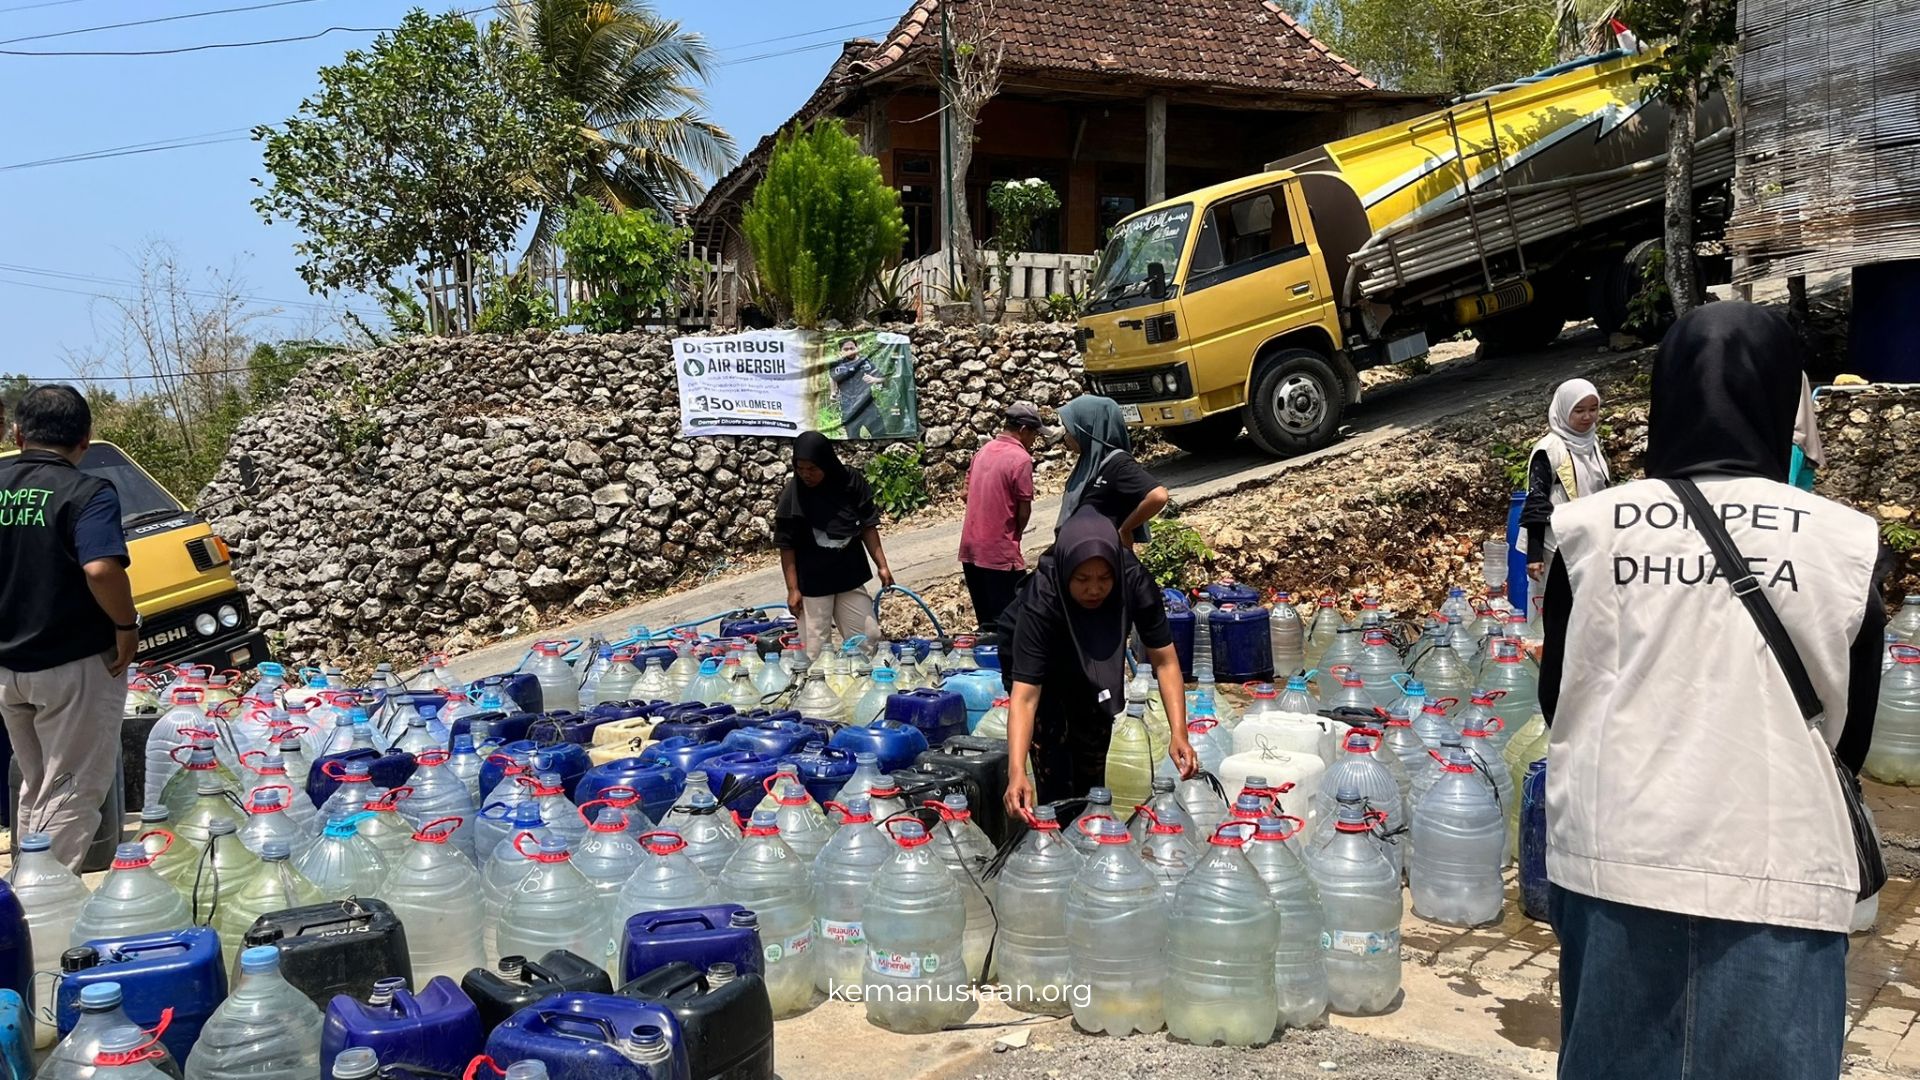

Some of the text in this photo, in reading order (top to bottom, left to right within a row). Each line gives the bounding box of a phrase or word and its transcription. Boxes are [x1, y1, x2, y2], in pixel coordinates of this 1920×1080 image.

[683, 341, 784, 354] DISTRIBUSI
[708, 358, 786, 374] AIR BERSIH
[735, 399, 783, 411] KILOMETER
[0, 488, 54, 506] MPET
[879, 957, 912, 970] Minerale
[891, 952, 902, 962] Le
